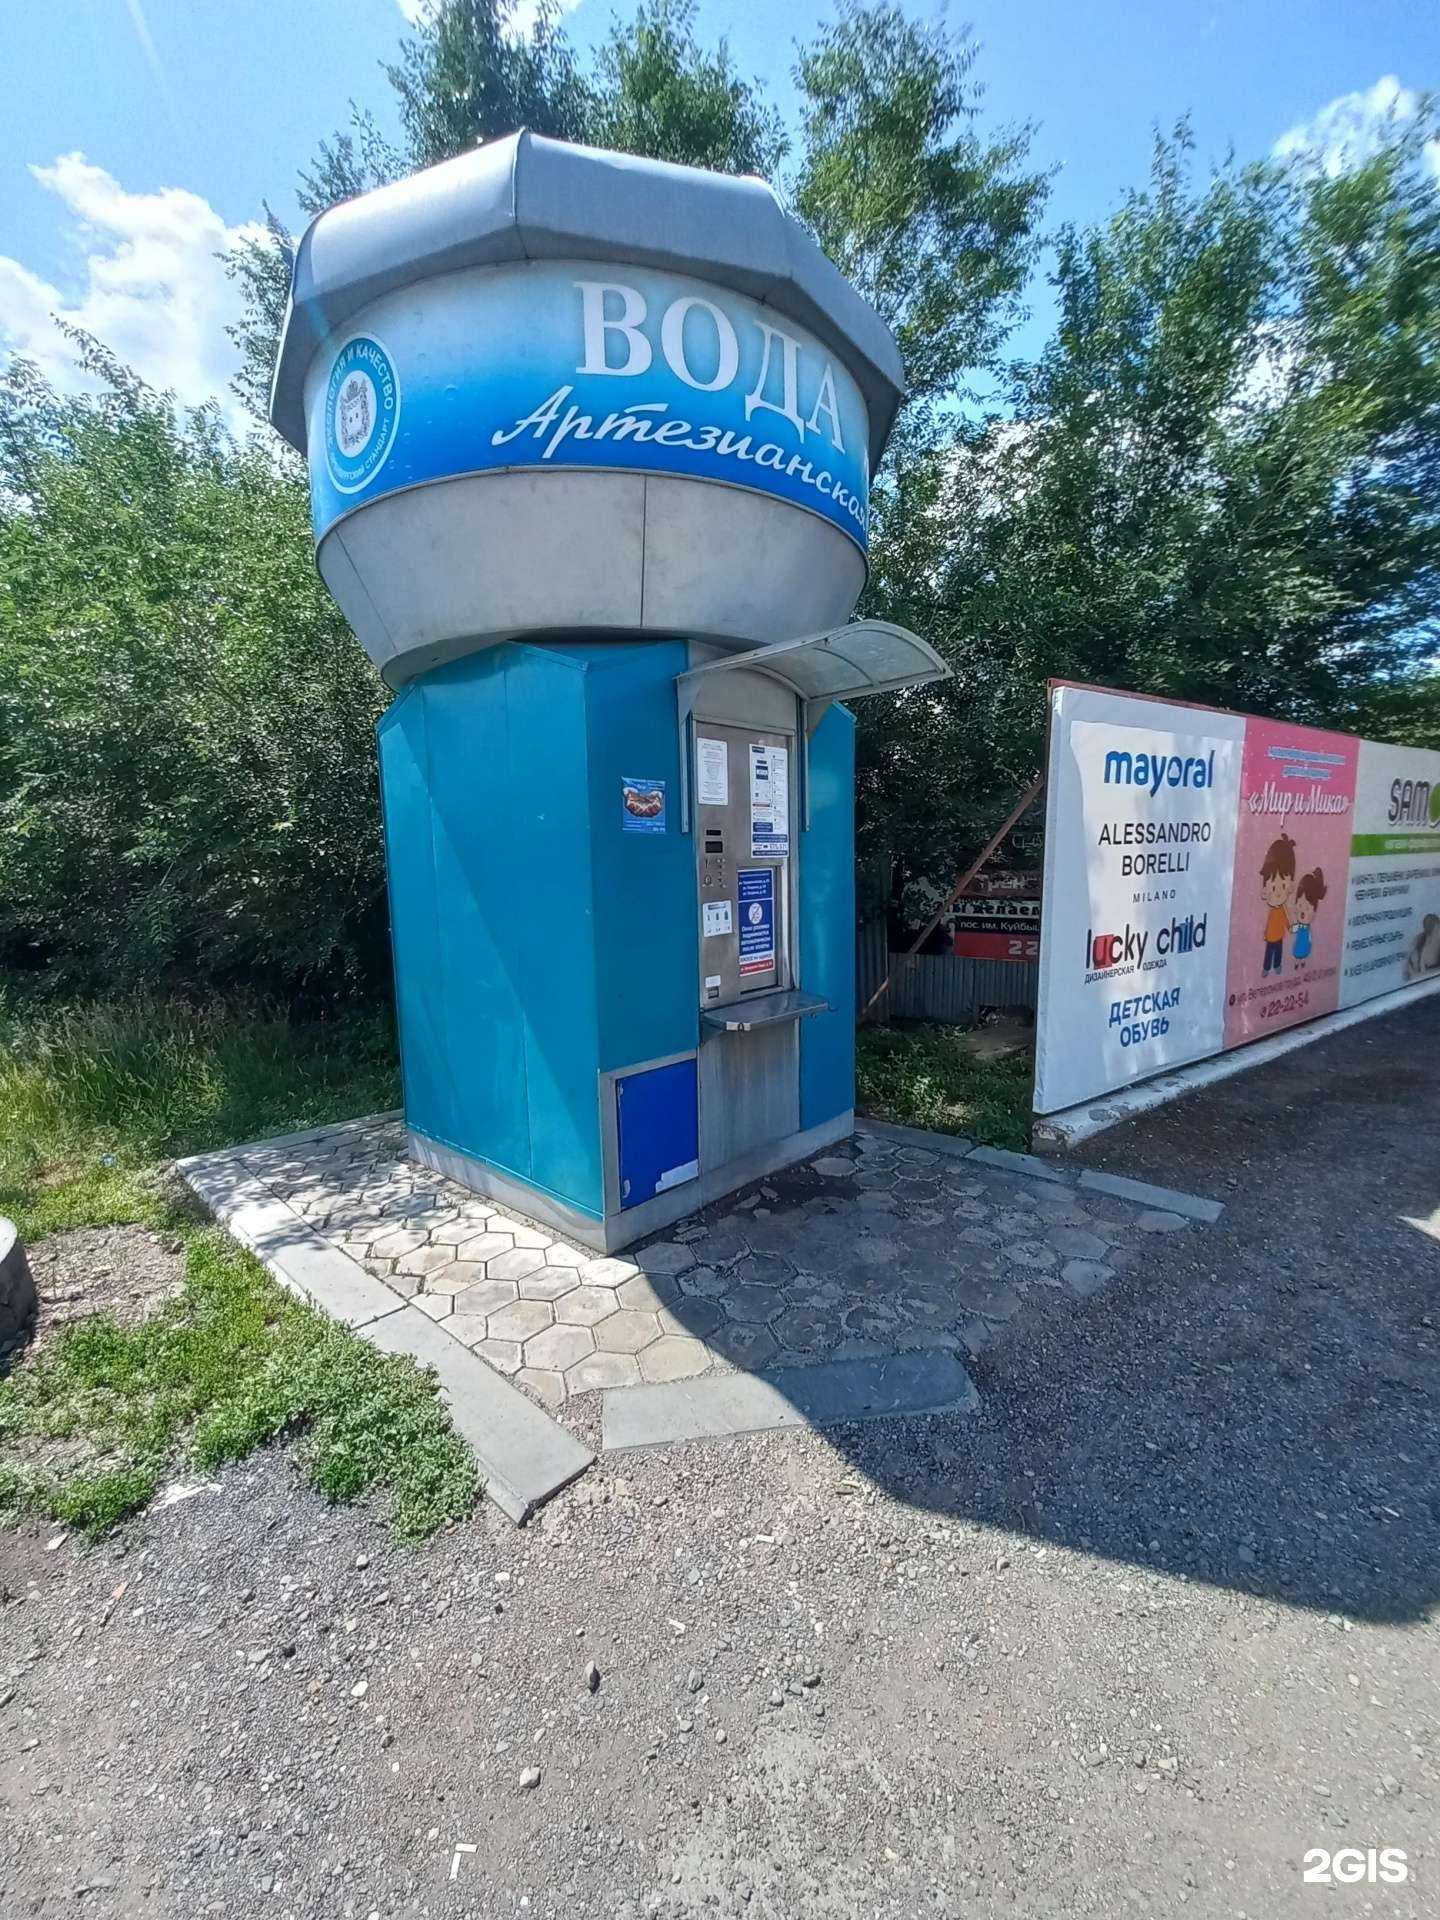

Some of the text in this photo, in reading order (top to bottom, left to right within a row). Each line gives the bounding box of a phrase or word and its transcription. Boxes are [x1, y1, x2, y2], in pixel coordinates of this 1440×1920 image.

[356, 344, 394, 411] КАЧЕСТВО
[573, 281, 846, 455] ВОДА
[364, 417, 391, 470] СТАНДАРТ
[1104, 750, 1216, 798] mayoral
[1098, 822, 1211, 846] ALESSANDRO
[1122, 852, 1190, 876] BORELLI
[1133, 889, 1176, 903] MILANO
[1086, 912, 1208, 970] lucky child
[1085, 959, 1168, 985] ДИЗАЙНЕРСКАЯ ОДЕЖДА
[1109, 987, 1181, 1028] ДЕТСКАЯ
[1120, 1016, 1170, 1048] ОБУВЬ
